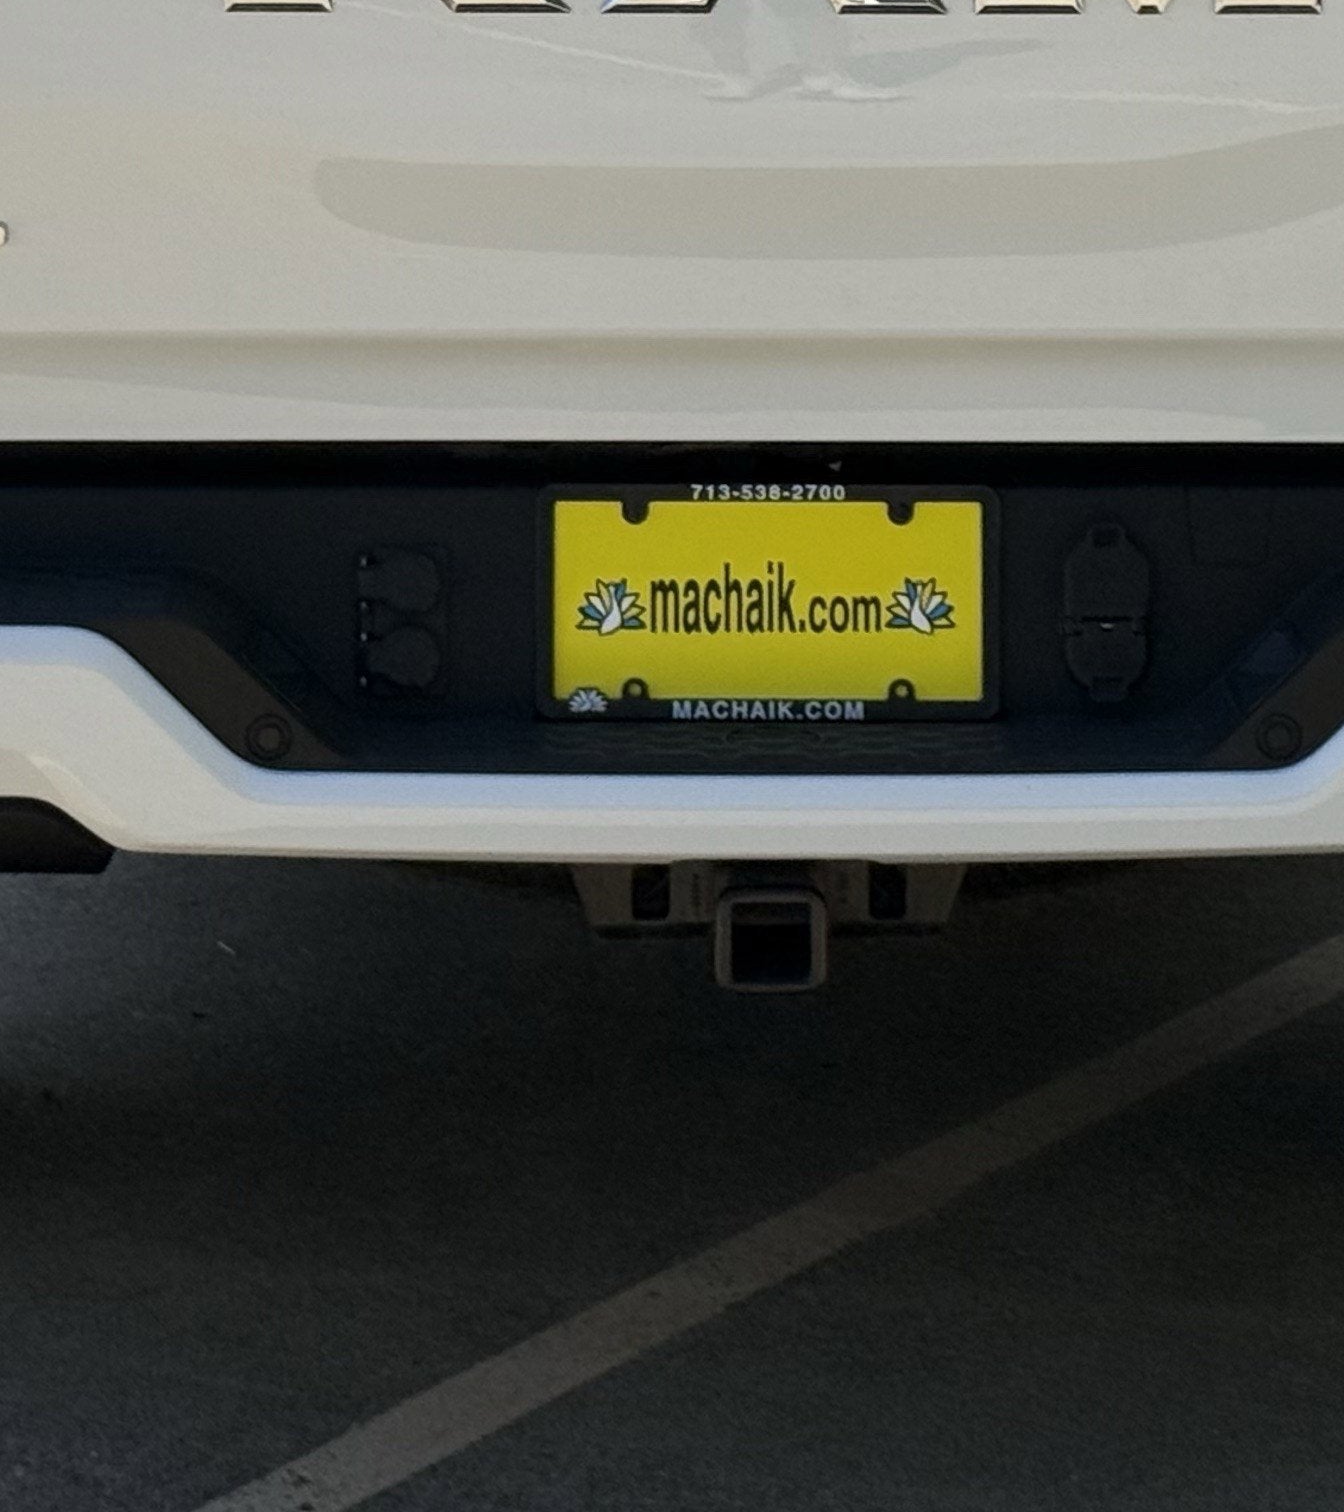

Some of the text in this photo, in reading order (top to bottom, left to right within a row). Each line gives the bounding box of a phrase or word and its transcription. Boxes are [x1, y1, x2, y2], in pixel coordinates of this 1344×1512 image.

[690, 483, 846, 501] 713-538-2700
[649, 560, 882, 634] machaik.com
[671, 700, 865, 720] MACHAIK.COM
